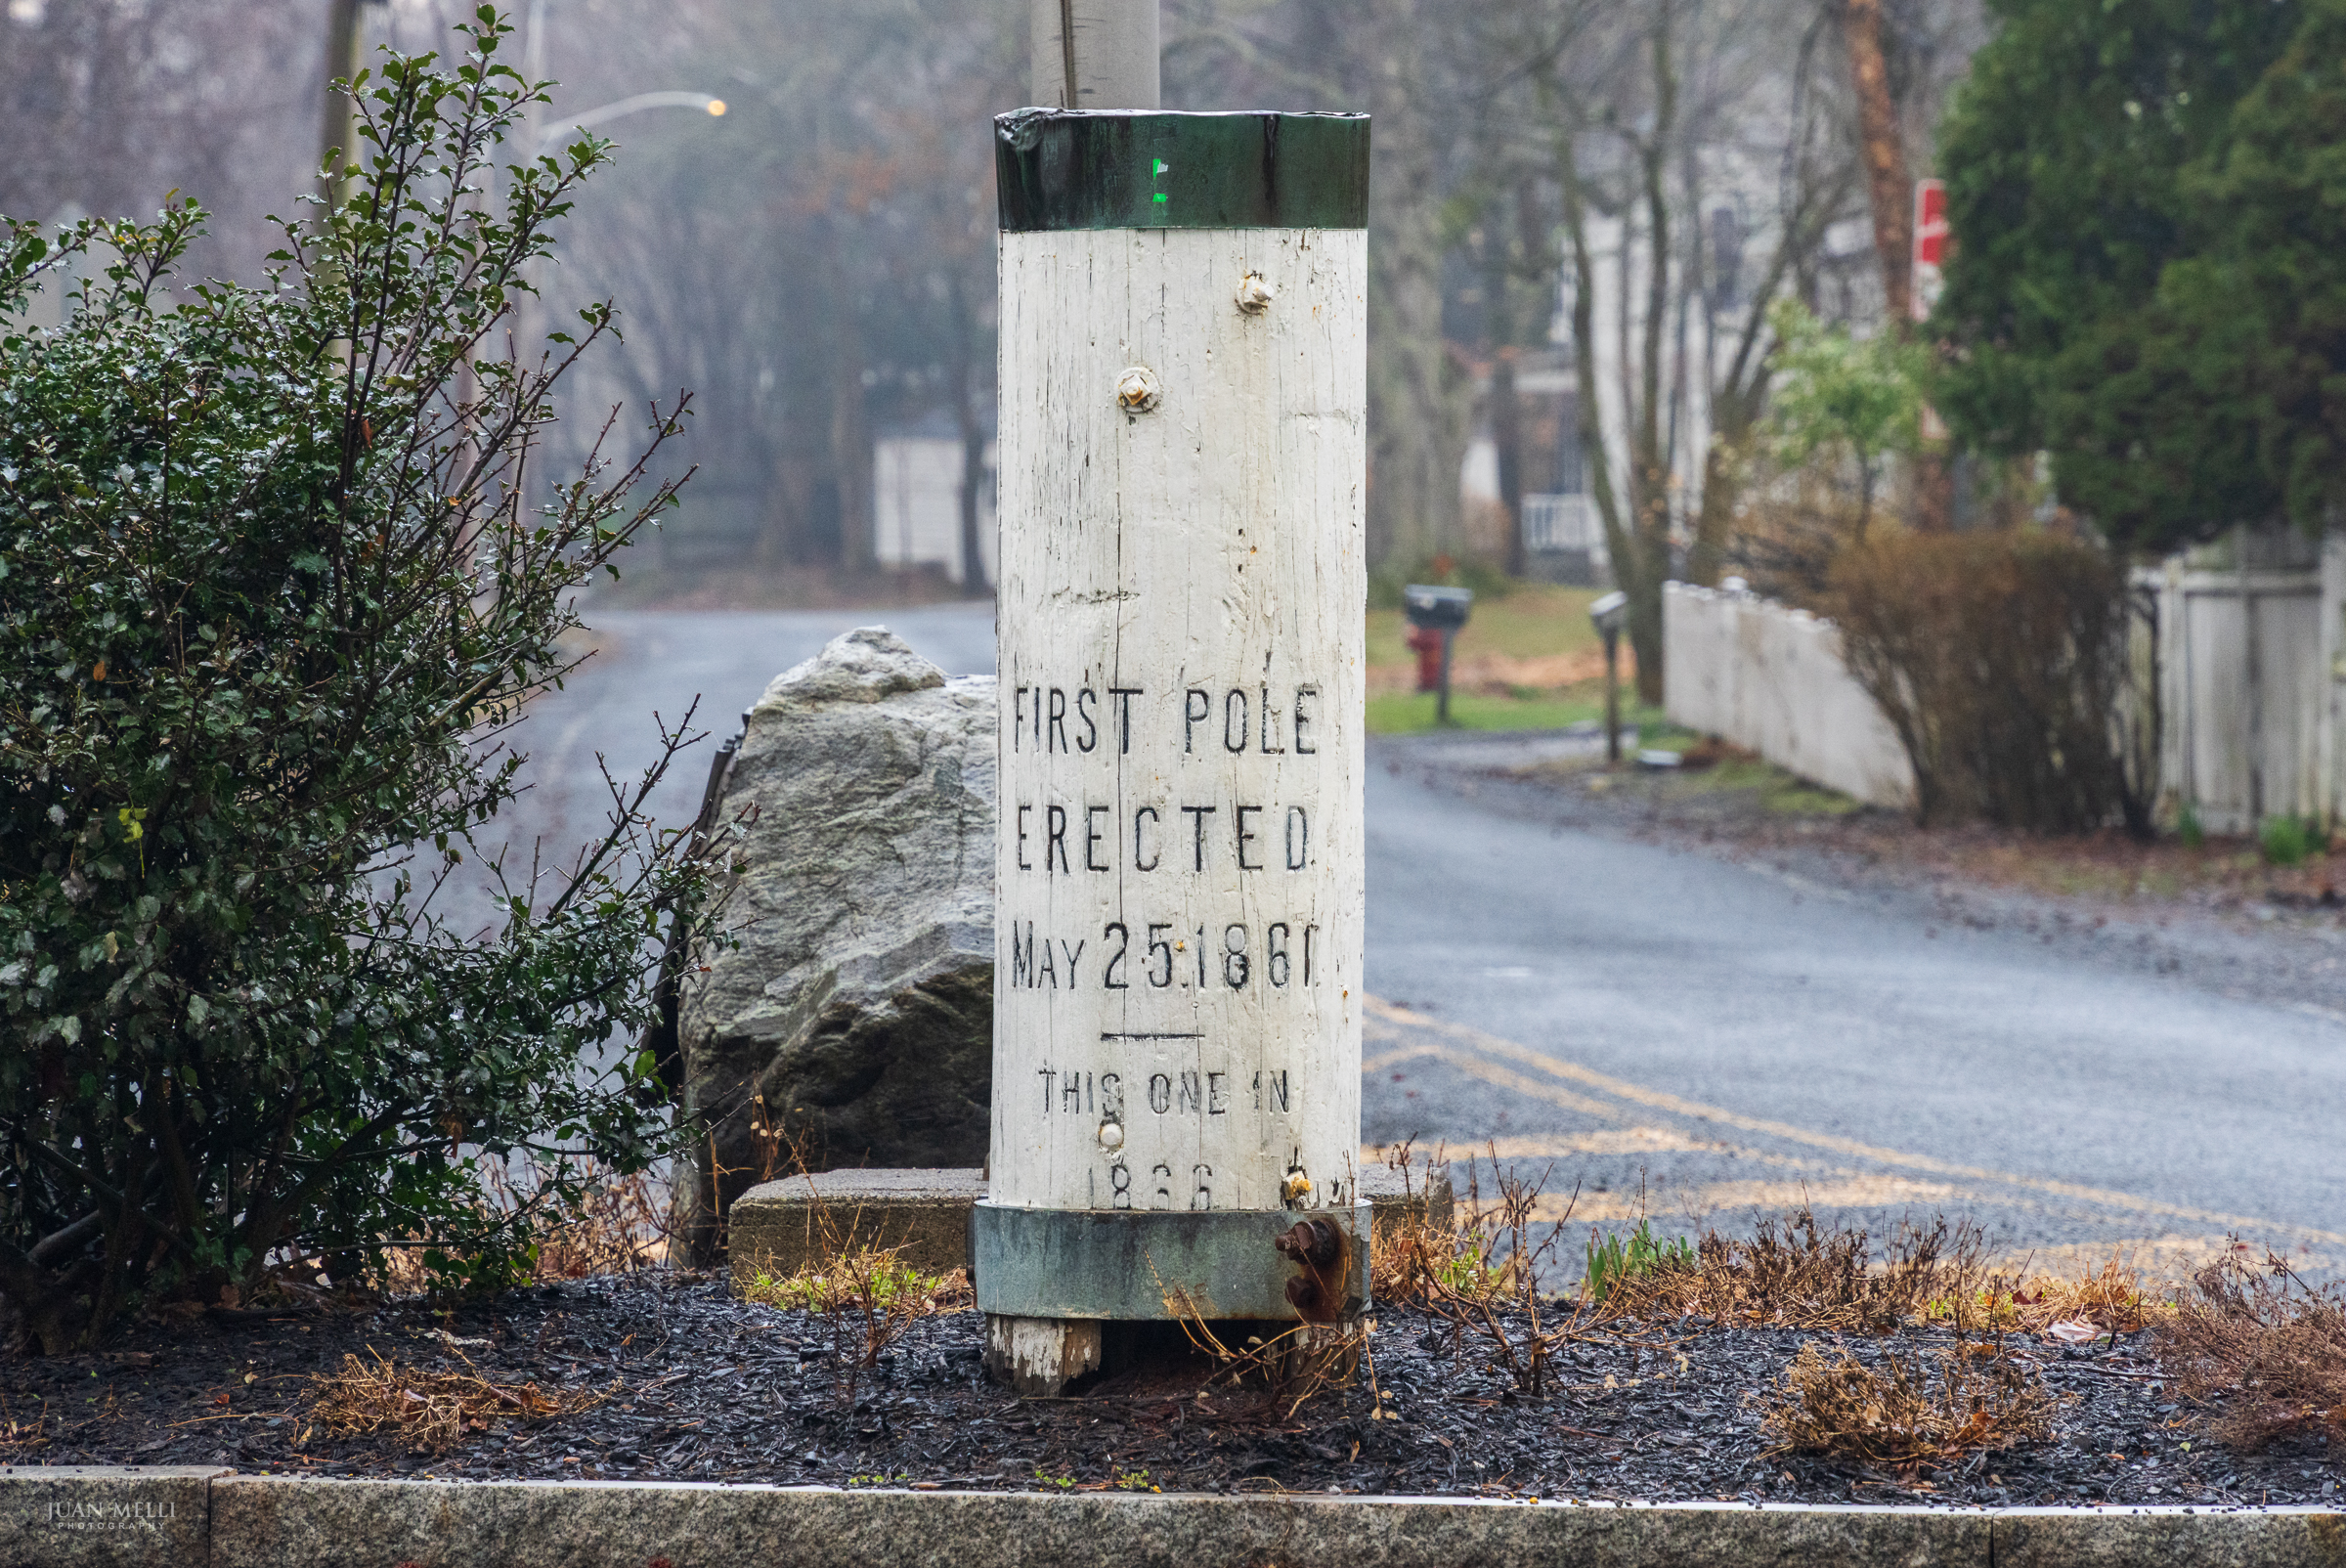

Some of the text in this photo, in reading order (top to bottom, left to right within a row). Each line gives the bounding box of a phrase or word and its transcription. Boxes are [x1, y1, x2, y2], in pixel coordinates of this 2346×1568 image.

[1014, 687, 1318, 755] FIRST POLE
[1018, 804, 1308, 873] ERECTED
[1012, 920, 1085, 990] MAY
[1038, 1066, 1289, 1117] THIS ONE IN
